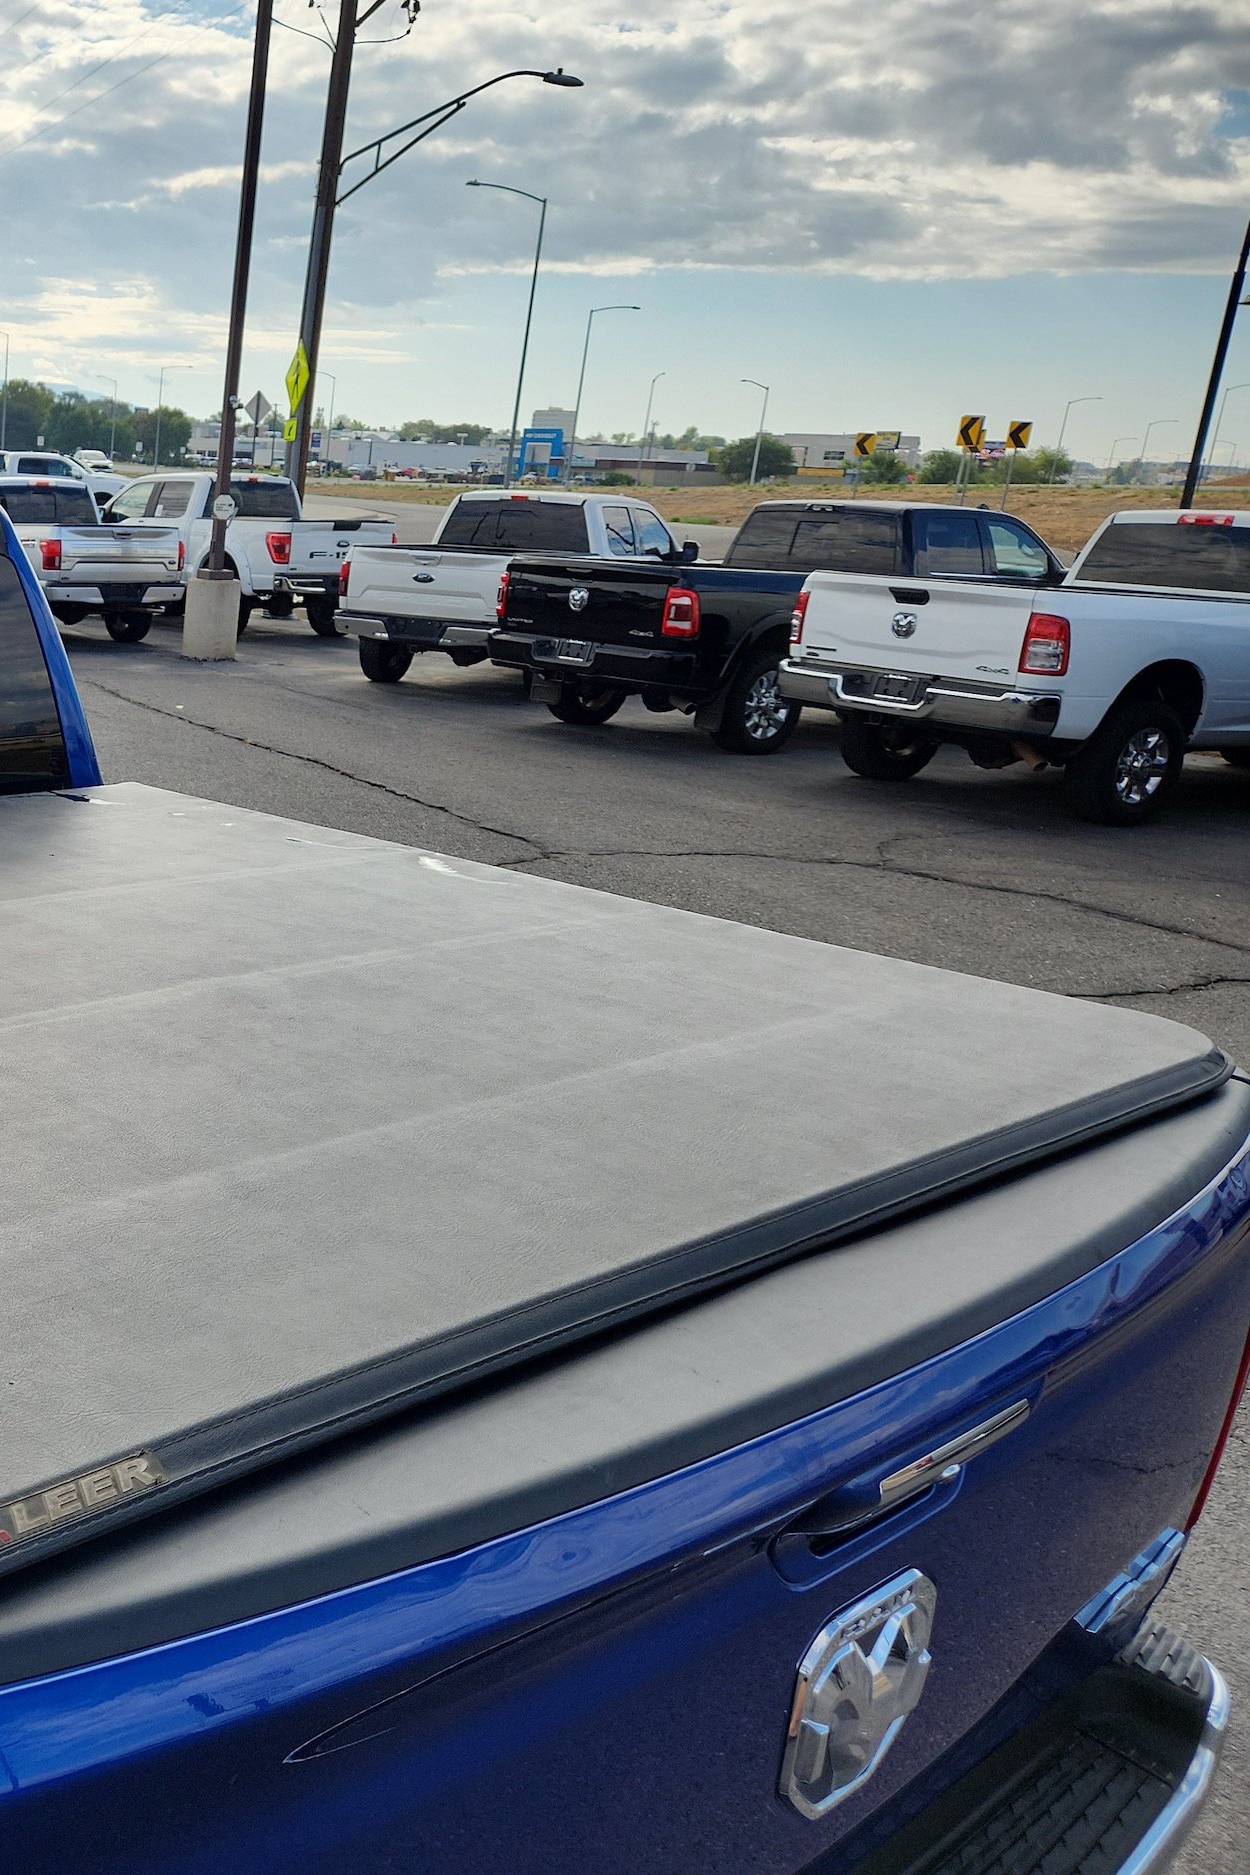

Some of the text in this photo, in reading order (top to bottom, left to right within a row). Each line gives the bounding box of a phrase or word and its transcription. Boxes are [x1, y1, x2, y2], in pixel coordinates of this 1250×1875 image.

[309, 551, 349, 560] F-15
[9, 1456, 156, 1534] LEER
[838, 1586, 917, 1646] RAM
